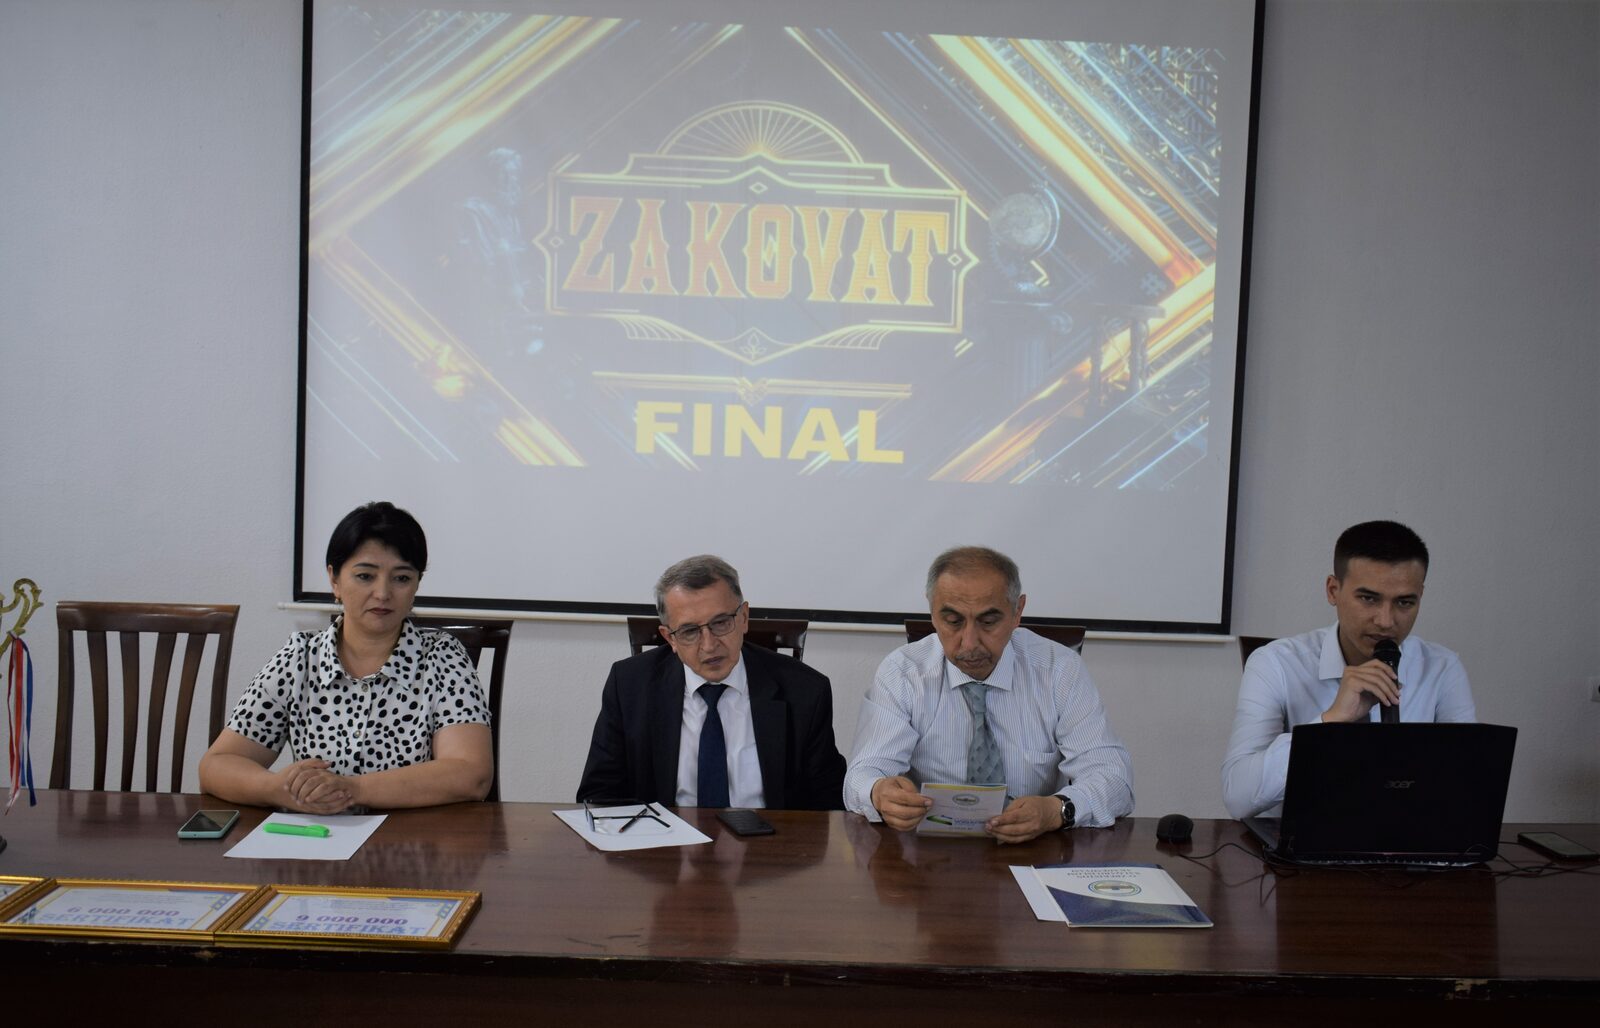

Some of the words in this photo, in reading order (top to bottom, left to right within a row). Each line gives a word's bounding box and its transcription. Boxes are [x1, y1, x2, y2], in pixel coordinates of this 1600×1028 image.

[562, 195, 950, 307] ZAKOVAT
[635, 400, 905, 465] FINAL
[1384, 780, 1415, 789] acer
[67, 906, 82, 914] 6
[88, 907, 131, 915] 000
[137, 908, 180, 917] 000
[40, 912, 195, 926] SERTIFIKAT
[295, 914, 309, 922] 9
[317, 915, 359, 923] 000
[366, 916, 408, 925] 000
[272, 920, 426, 935] SERTIFIKAT
